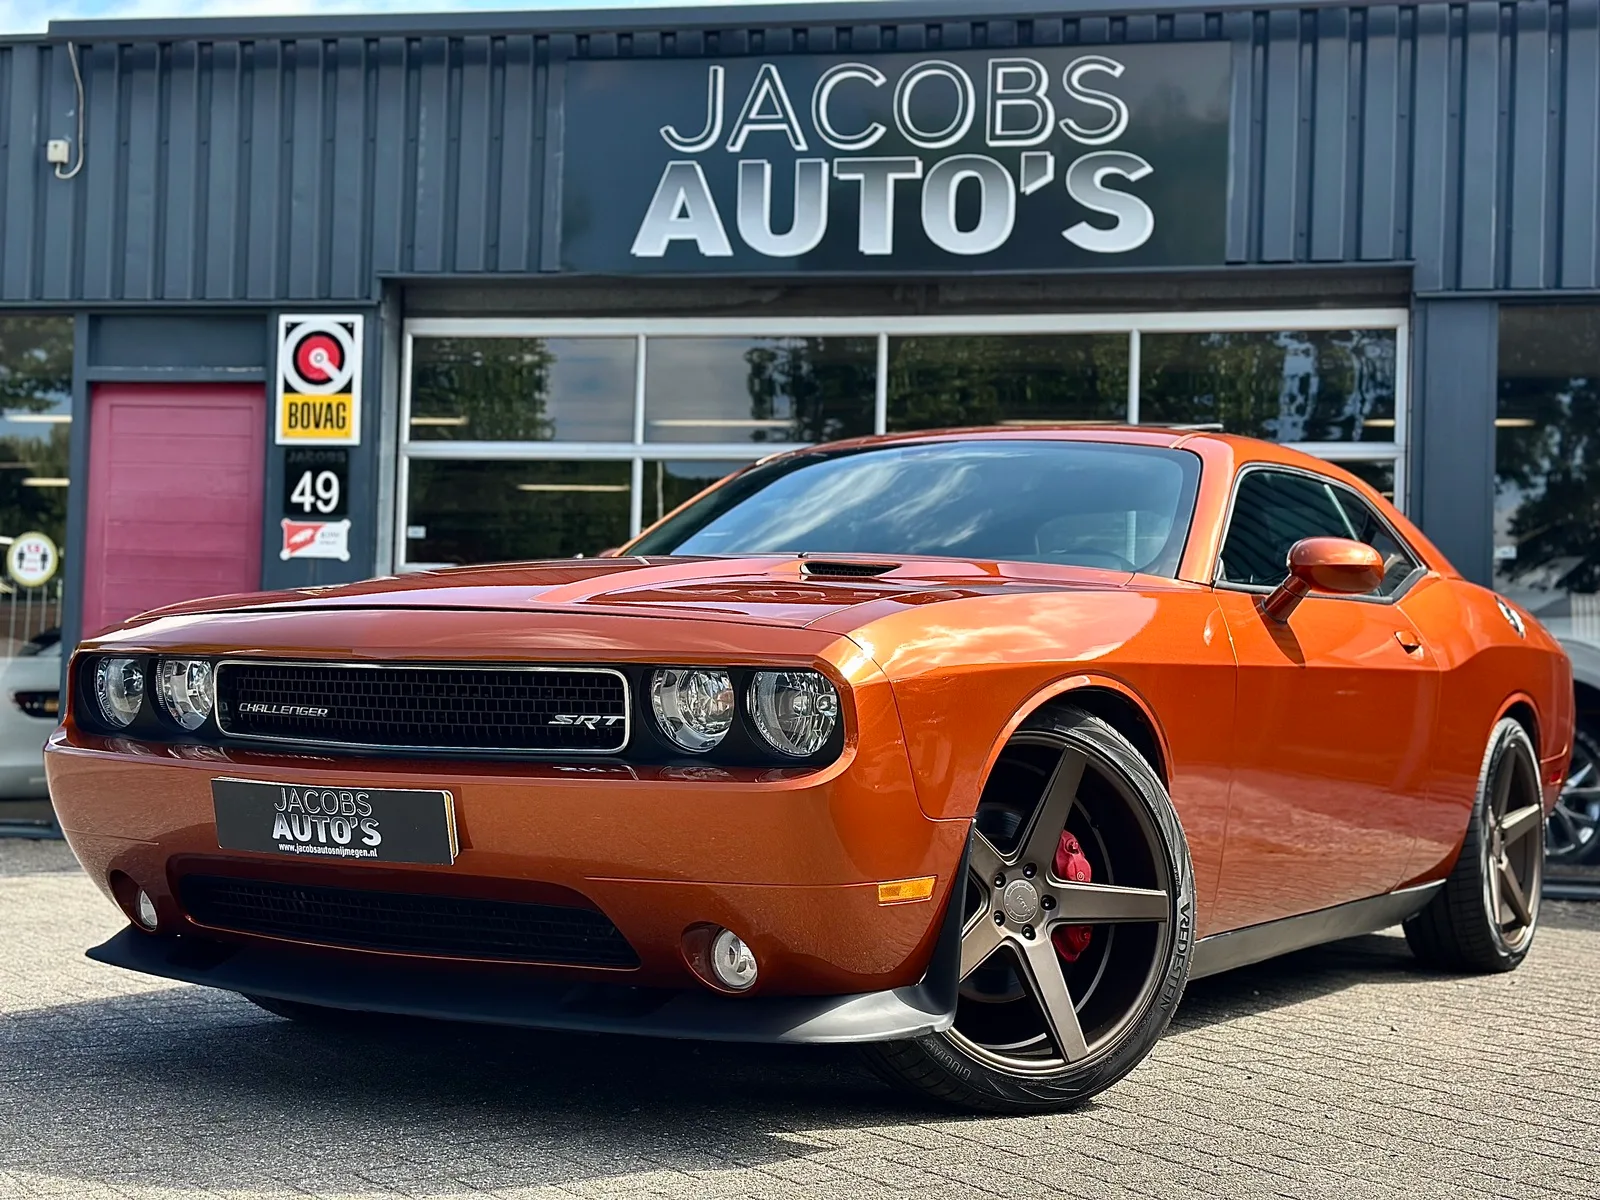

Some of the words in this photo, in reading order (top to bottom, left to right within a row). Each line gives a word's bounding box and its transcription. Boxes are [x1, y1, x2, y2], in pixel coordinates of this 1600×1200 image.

[659, 55, 1129, 153] JACOBS
[630, 150, 1155, 257] AUTO'S
[288, 401, 346, 430] BOVAG
[290, 470, 340, 513] 49
[238, 702, 328, 718] CHALLENGER
[547, 714, 626, 730] SRT
[273, 787, 372, 817] JACOBS
[272, 812, 382, 847] AUTO'S
[278, 843, 378, 859] www.jacobsautosnijmegen.nl
[1159, 901, 1190, 1012] VREDESTEIN
